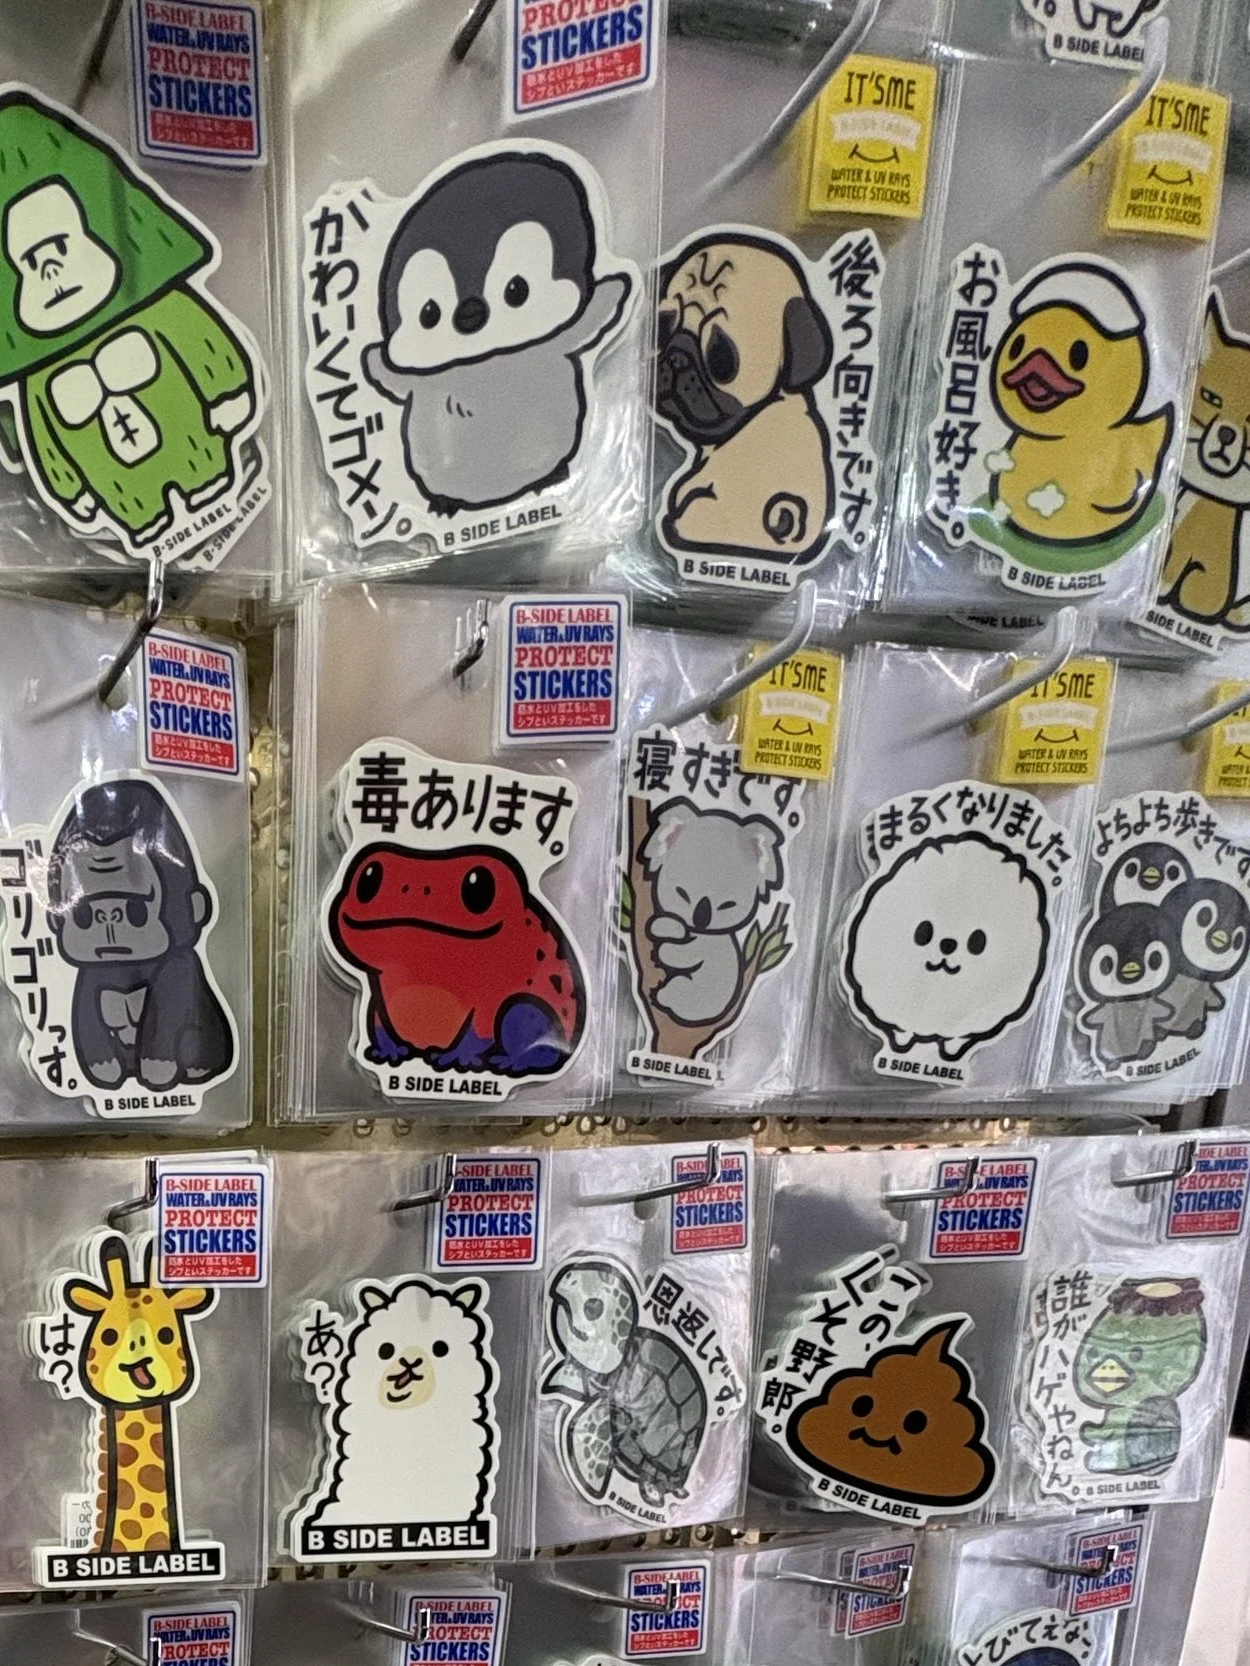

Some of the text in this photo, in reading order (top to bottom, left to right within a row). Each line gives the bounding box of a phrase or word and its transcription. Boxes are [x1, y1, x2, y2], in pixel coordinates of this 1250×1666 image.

[522, 4, 643, 70] STICKERS
[150, 76, 250, 119] STICKERS
[827, 184, 866, 200] PROTECT
[310, 189, 412, 541] かわいくてゴメン。
[827, 235, 880, 549] 後ろ向きです。
[935, 250, 1001, 541] お風呂好き。
[193, 503, 231, 536] LABEL
[460, 516, 500, 543] SIDE
[505, 505, 563, 535] LABEL
[699, 562, 734, 581] SIDE
[740, 566, 791, 587] LABEL
[1021, 570, 1053, 590] SIDE
[1058, 573, 1106, 591] LABEL
[515, 645, 612, 668] PROTECT
[149, 679, 231, 709] PROTECT
[514, 669, 612, 700] STICKERS
[150, 701, 233, 740] STICKERS
[352, 751, 572, 857] 毒あります。
[877, 786, 1072, 887] まるくなりました。
[644, 1059, 671, 1075] SIDE
[675, 1062, 712, 1081] LABEL
[891, 1060, 920, 1076] SIDE
[924, 1063, 964, 1081] LABEL
[405, 1077, 444, 1093] SIDE
[449, 1080, 502, 1096] LABEL
[118, 1096, 150, 1109] SIDE
[154, 1094, 196, 1108] LABEL
[675, 1202, 743, 1227] STICKERS
[1173, 1190, 1242, 1213] STICKERS
[165, 1208, 257, 1229] PROTECT
[445, 1211, 532, 1237] STICKERS
[938, 1208, 1023, 1232] STICKERS
[165, 1229, 256, 1254] STICKERS
[644, 1272, 743, 1417] 恩返しです。
[761, 1256, 880, 1433] くそ野郎。
[1037, 1269, 1096, 1496] 誰がハゲやねん。
[833, 1483, 869, 1508] SIDE
[871, 1496, 921, 1521] LABEL
[308, 1523, 485, 1551] B SIDE LABEL
[53, 1552, 215, 1579] B SIDE LABEL
[630, 1611, 699, 1632] STICKERS
[411, 1642, 489, 1662] STICKERS
